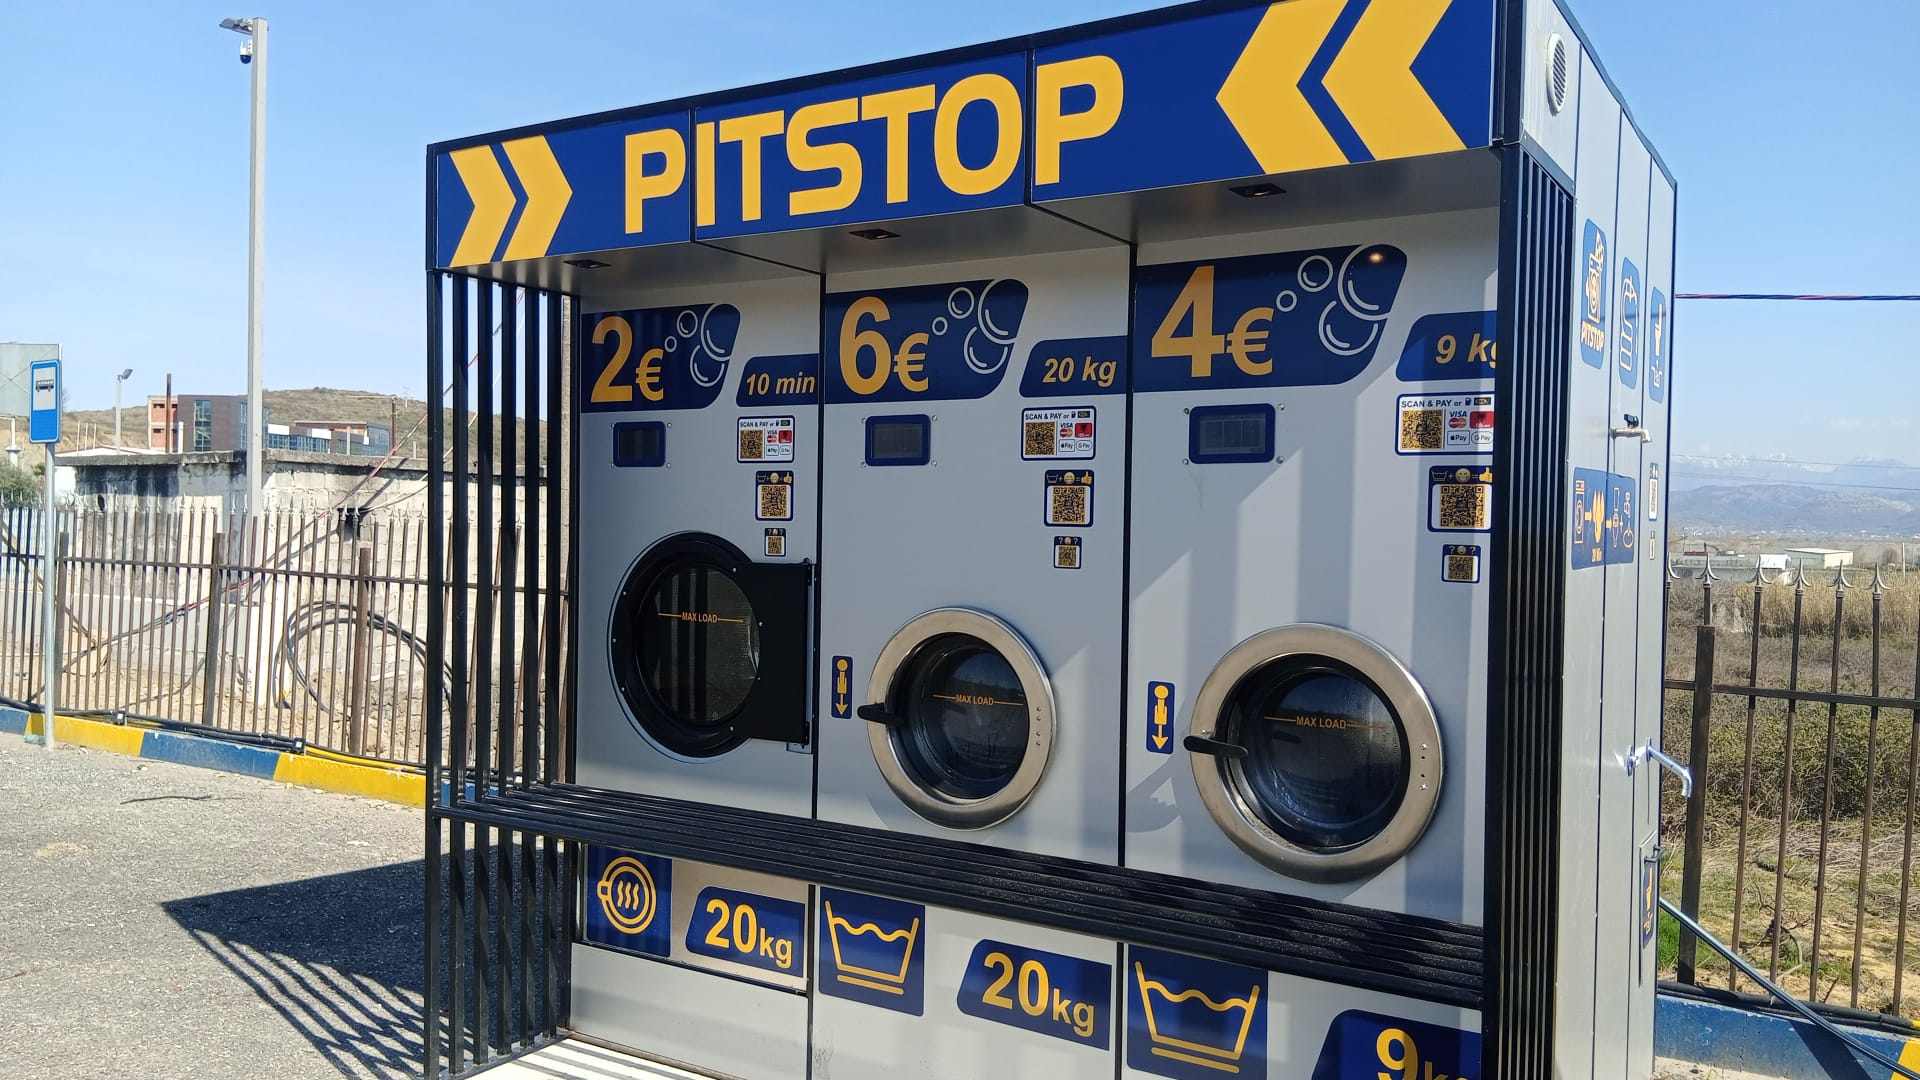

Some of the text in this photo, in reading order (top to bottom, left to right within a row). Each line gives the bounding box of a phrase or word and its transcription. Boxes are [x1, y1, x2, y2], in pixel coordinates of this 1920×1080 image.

[624, 54, 1125, 234] PITSTOP
[1151, 264, 1274, 377] 4€
[1581, 320, 1605, 352] PITSTOP
[590, 315, 664, 403] 2€
[839, 296, 929, 395] 6€
[1435, 334, 1456, 364] 9
[747, 371, 816, 396] 10 min
[1043, 356, 1117, 388] 20 kg
[1401, 400, 1425, 408] SCAN
[682, 611, 718, 623] MAX LOAD
[956, 694, 994, 706] MAX LOAD
[1296, 716, 1347, 729] MAX LOAD
[704, 898, 793, 968] 20kg
[982, 951, 1095, 1037] 20kg
